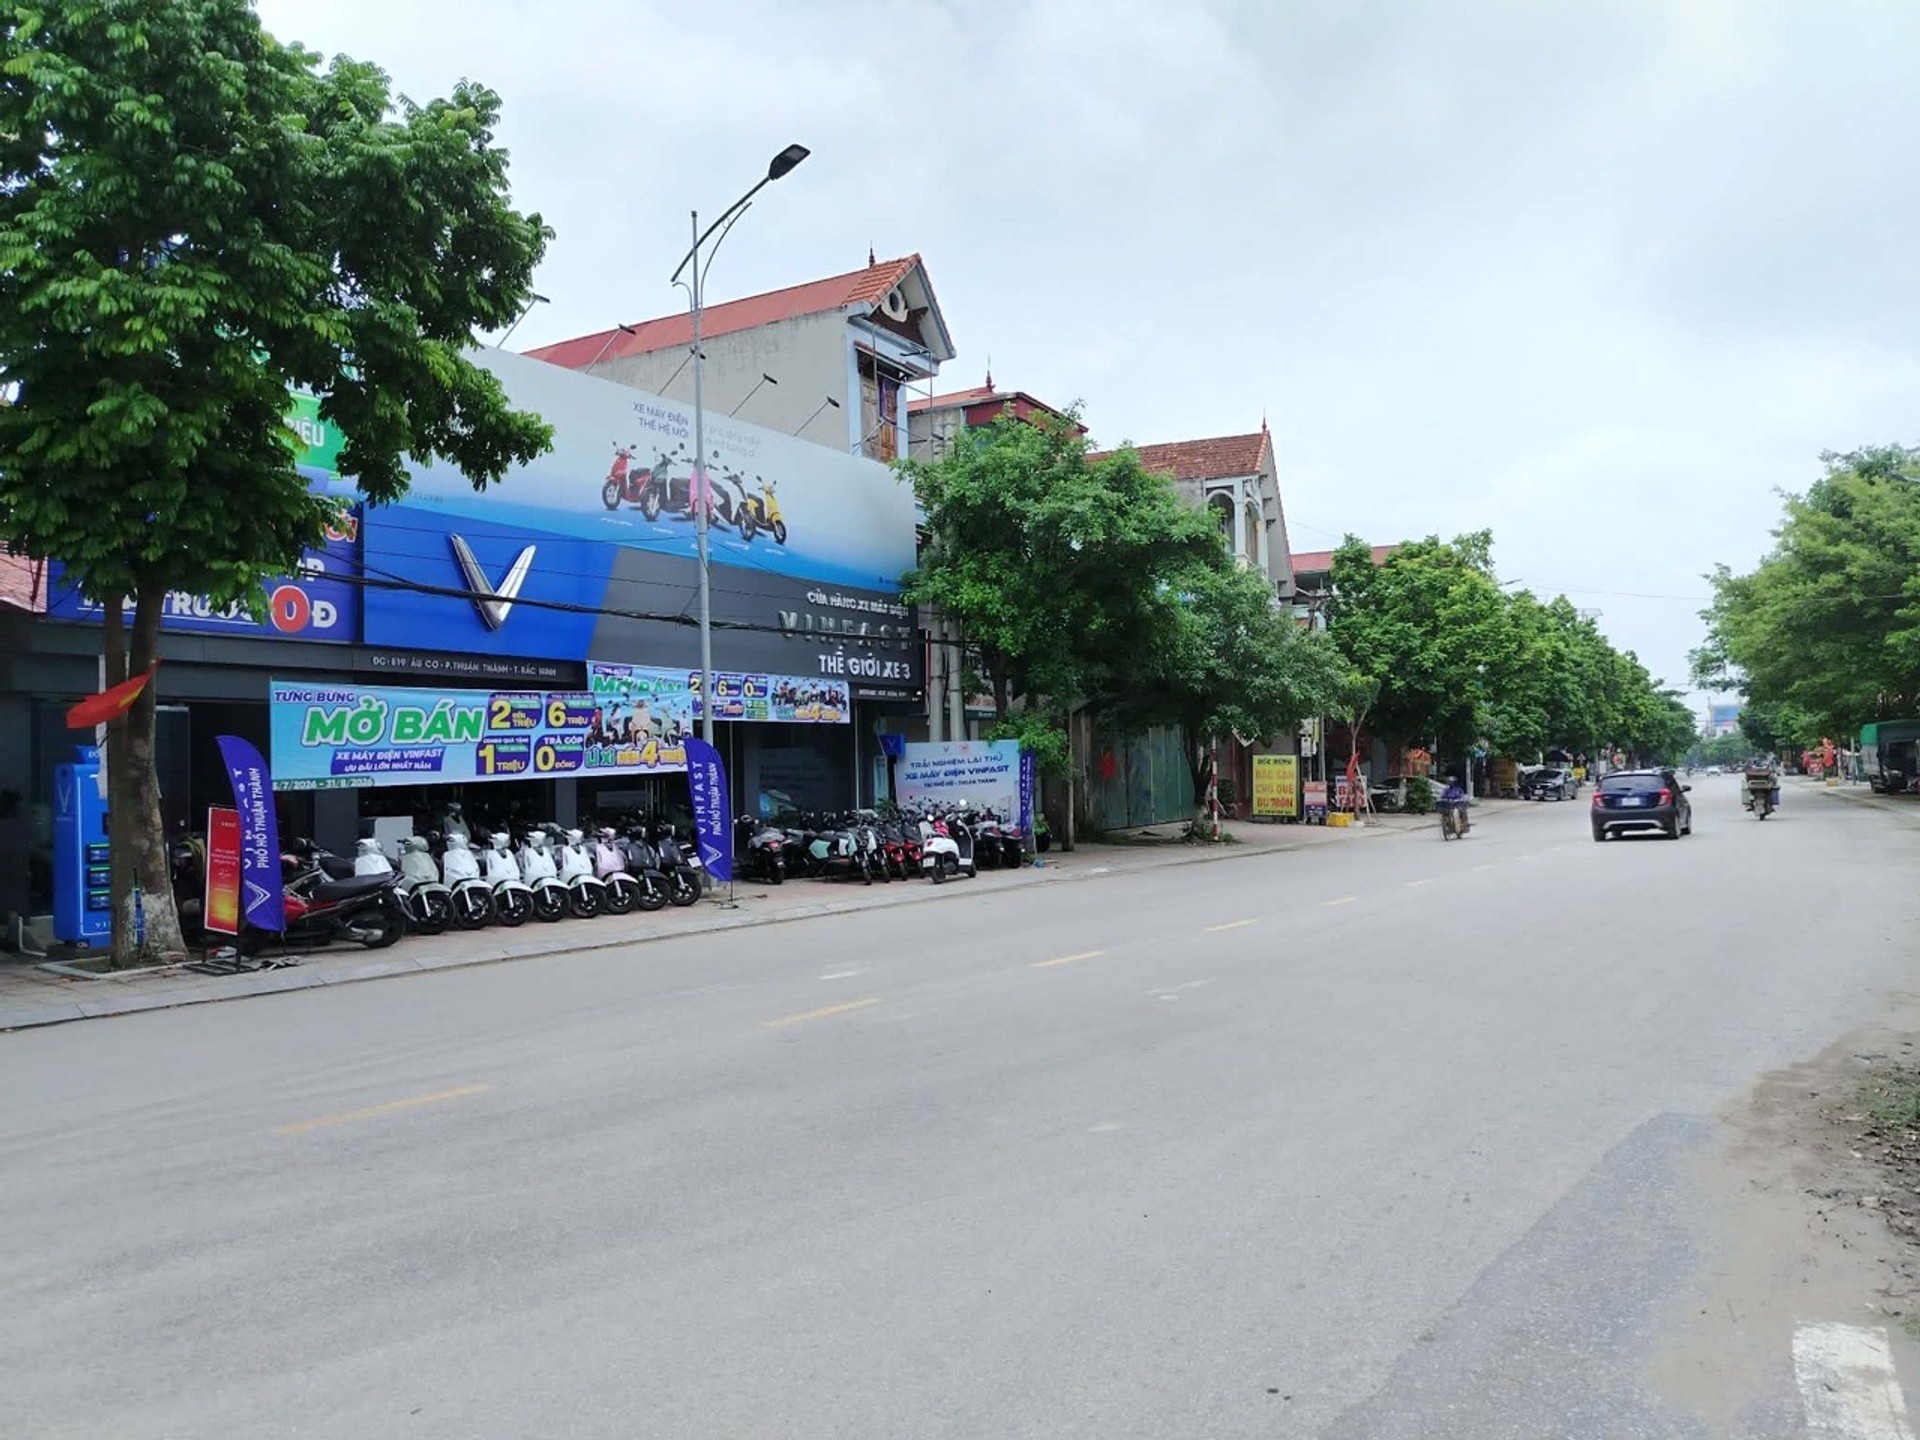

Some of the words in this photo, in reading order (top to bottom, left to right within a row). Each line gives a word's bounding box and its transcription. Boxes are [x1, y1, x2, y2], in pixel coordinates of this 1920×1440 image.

[819, 645, 845, 674] THẾ
[847, 652, 881, 677] GIỚI
[882, 660, 900, 679] XE
[718, 681, 728, 696] 6
[304, 696, 387, 743] MỞ
[391, 701, 485, 741] BÁN
[491, 700, 512, 729] 2
[547, 701, 567, 728] 6
[335, 751, 350, 761] XE
[478, 744, 495, 774] 1
[535, 745, 556, 771] 0
[640, 740, 659, 769] 4
[692, 761, 706, 835] VINFAST
